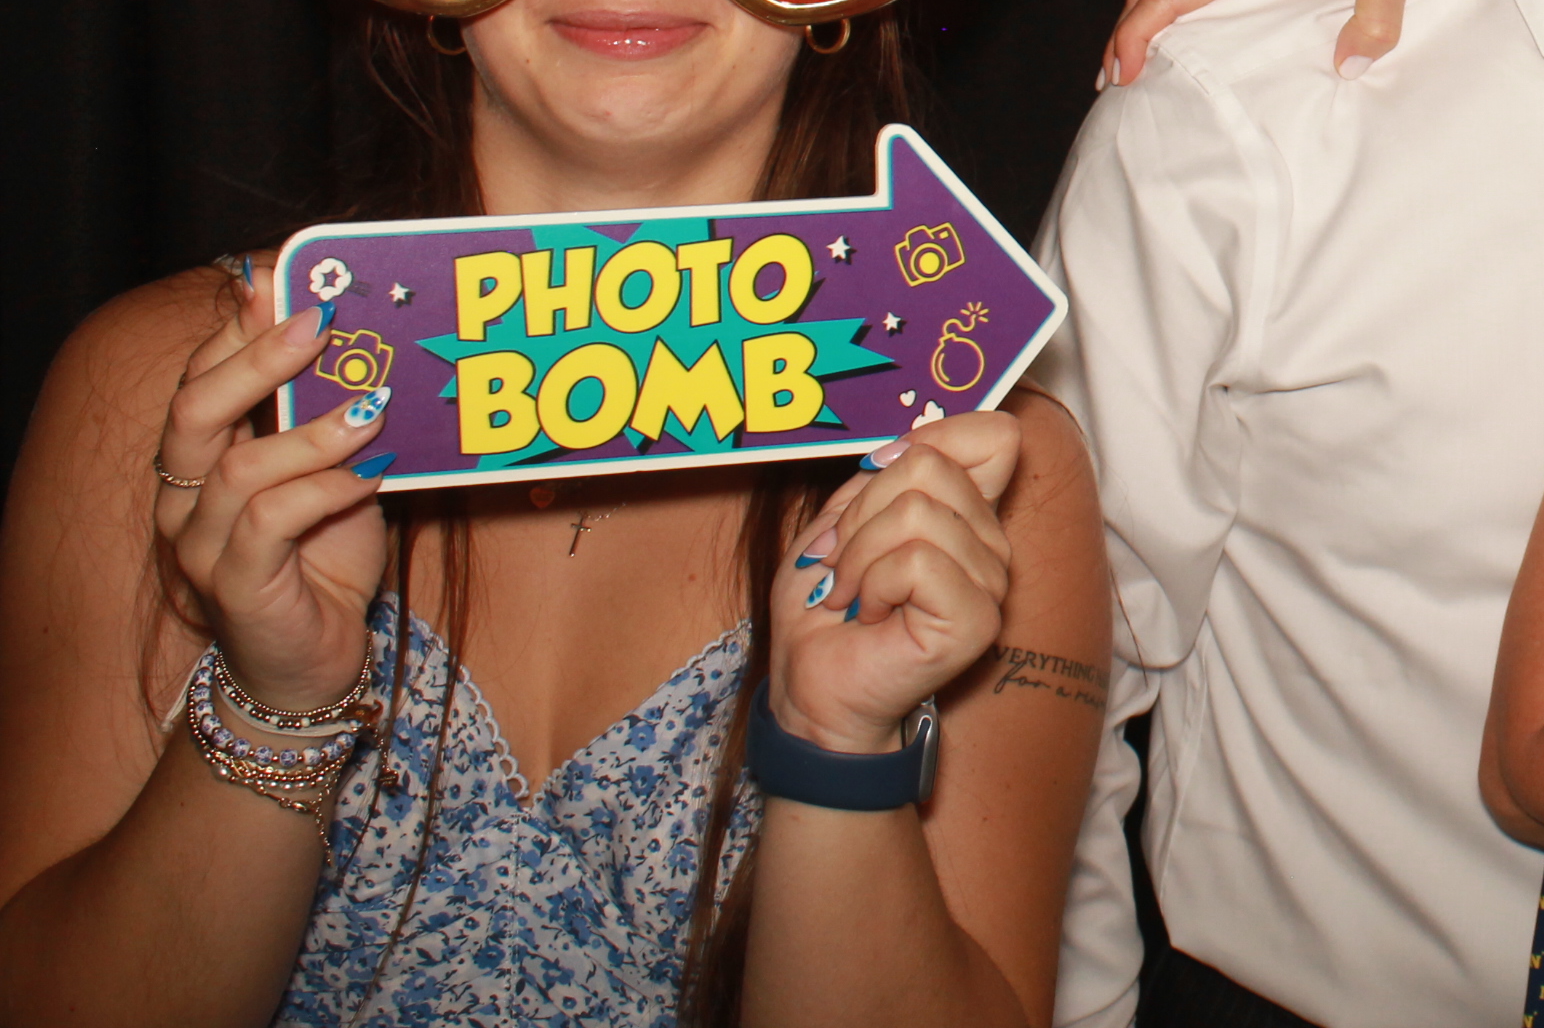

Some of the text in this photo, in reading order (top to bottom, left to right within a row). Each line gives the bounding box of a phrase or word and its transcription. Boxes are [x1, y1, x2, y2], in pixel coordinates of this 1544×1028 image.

[453, 232, 815, 342] PHOTO
[453, 333, 825, 455] BOMB
[992, 645, 1095, 683] VERYTHING
